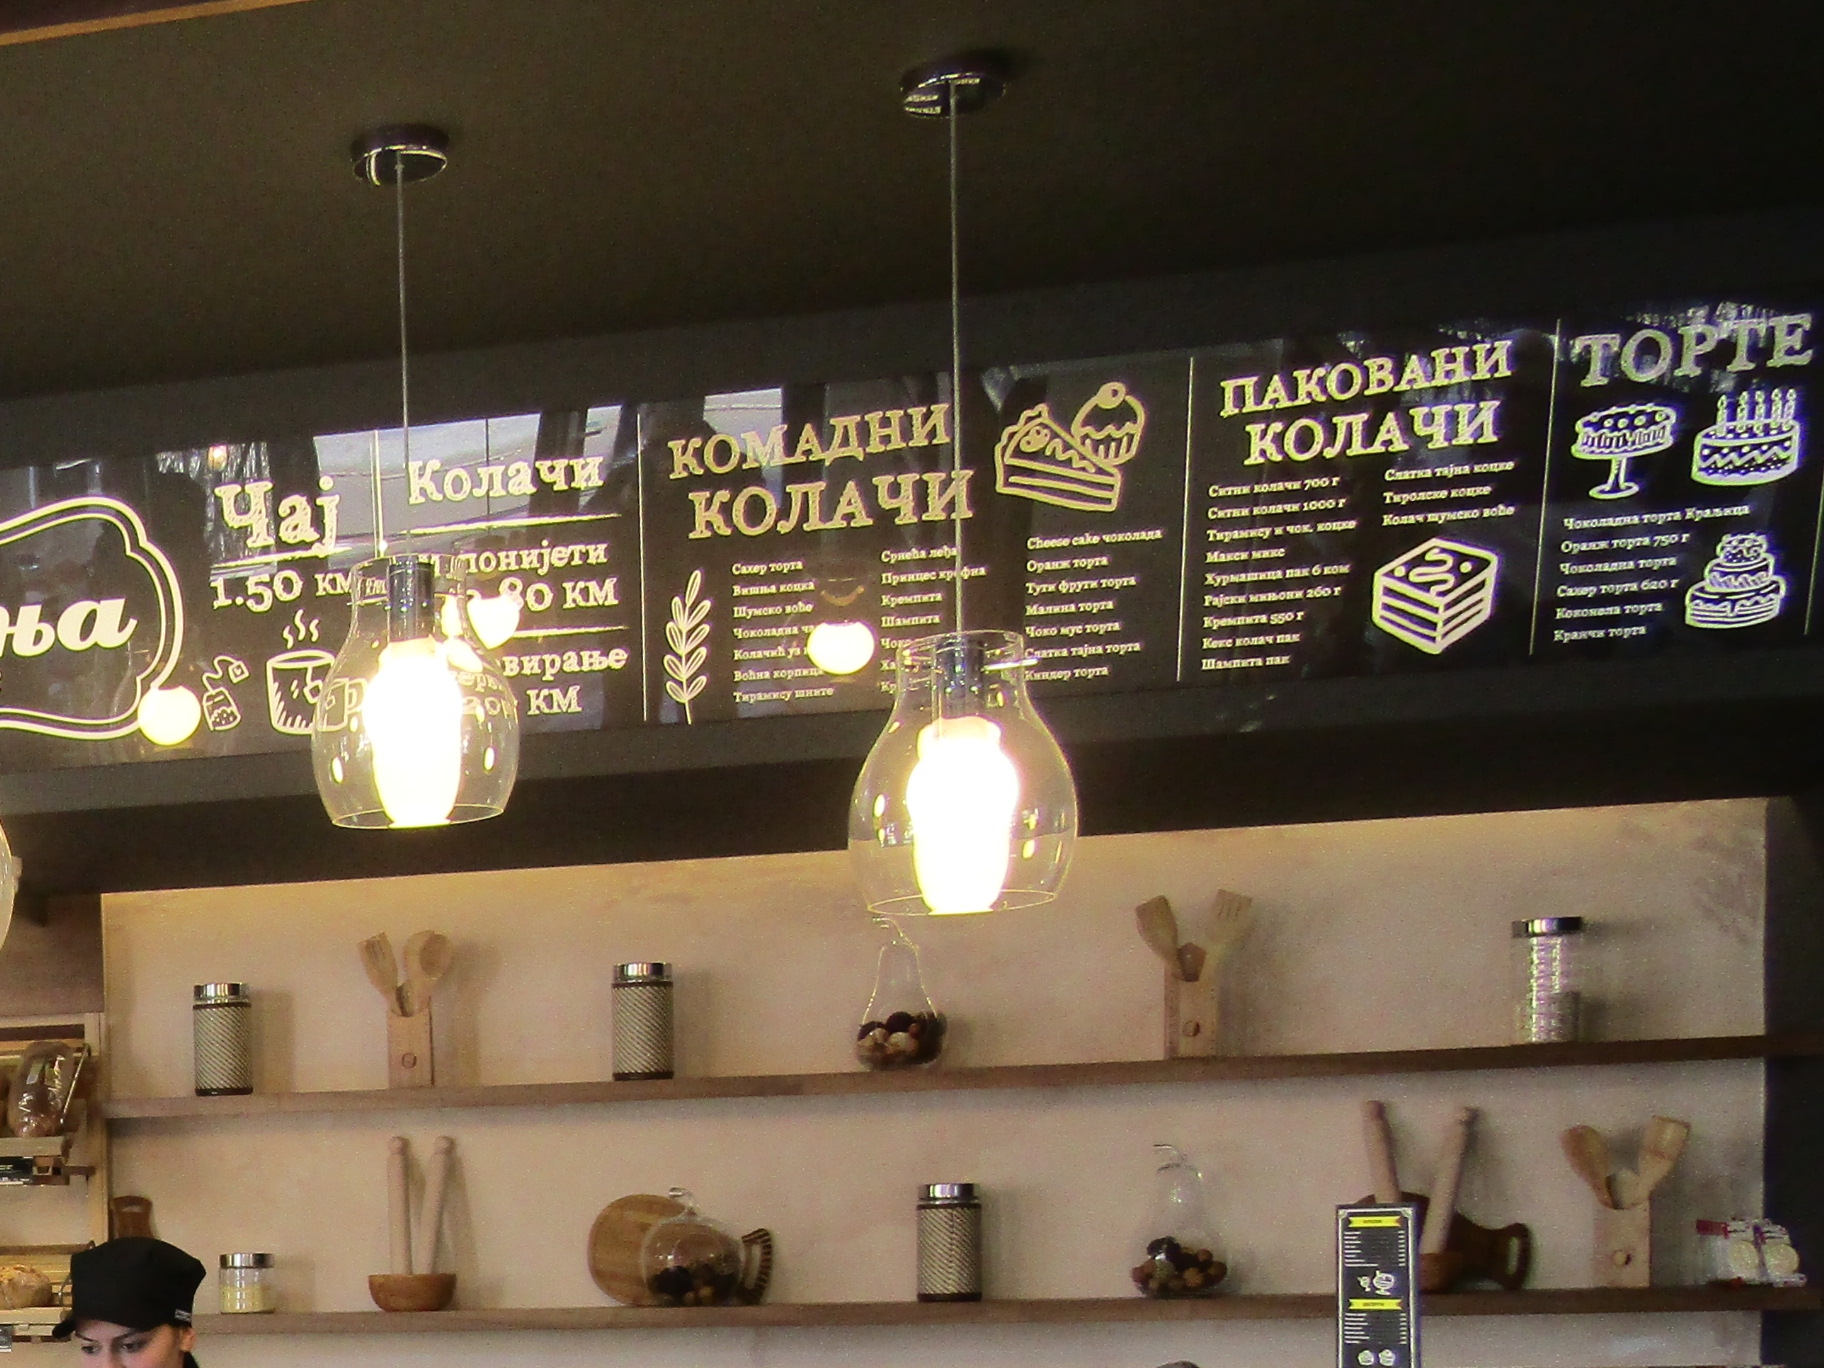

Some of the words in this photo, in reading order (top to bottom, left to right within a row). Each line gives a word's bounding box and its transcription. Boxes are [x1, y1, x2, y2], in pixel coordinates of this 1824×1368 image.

[1578, 313, 1813, 388] ТОРТЕ
[1219, 340, 1513, 417] ПАКОВАНИ
[668, 403, 951, 479] КОМАДНИ
[1243, 400, 1500, 466] КОЛАЧИ
[408, 455, 604, 504] Колачи
[1304, 477, 1329, 490] 700
[1384, 468, 1432, 481] Слатка
[1435, 464, 1470, 478] тајна
[215, 476, 341, 548] Чај
[688, 470, 974, 539] КОЛАЧИ
[1641, 511, 1683, 524] торта
[1612, 536, 1650, 550] торта
[769, 561, 803, 573] торта
[1073, 556, 1109, 569] торта
[1637, 556, 1677, 570] торта
[210, 569, 303, 613] 1.50
[562, 577, 618, 609] КМ
[1101, 576, 1136, 589] торта
[1078, 600, 1114, 613] торта
[526, 685, 582, 716] КМ
